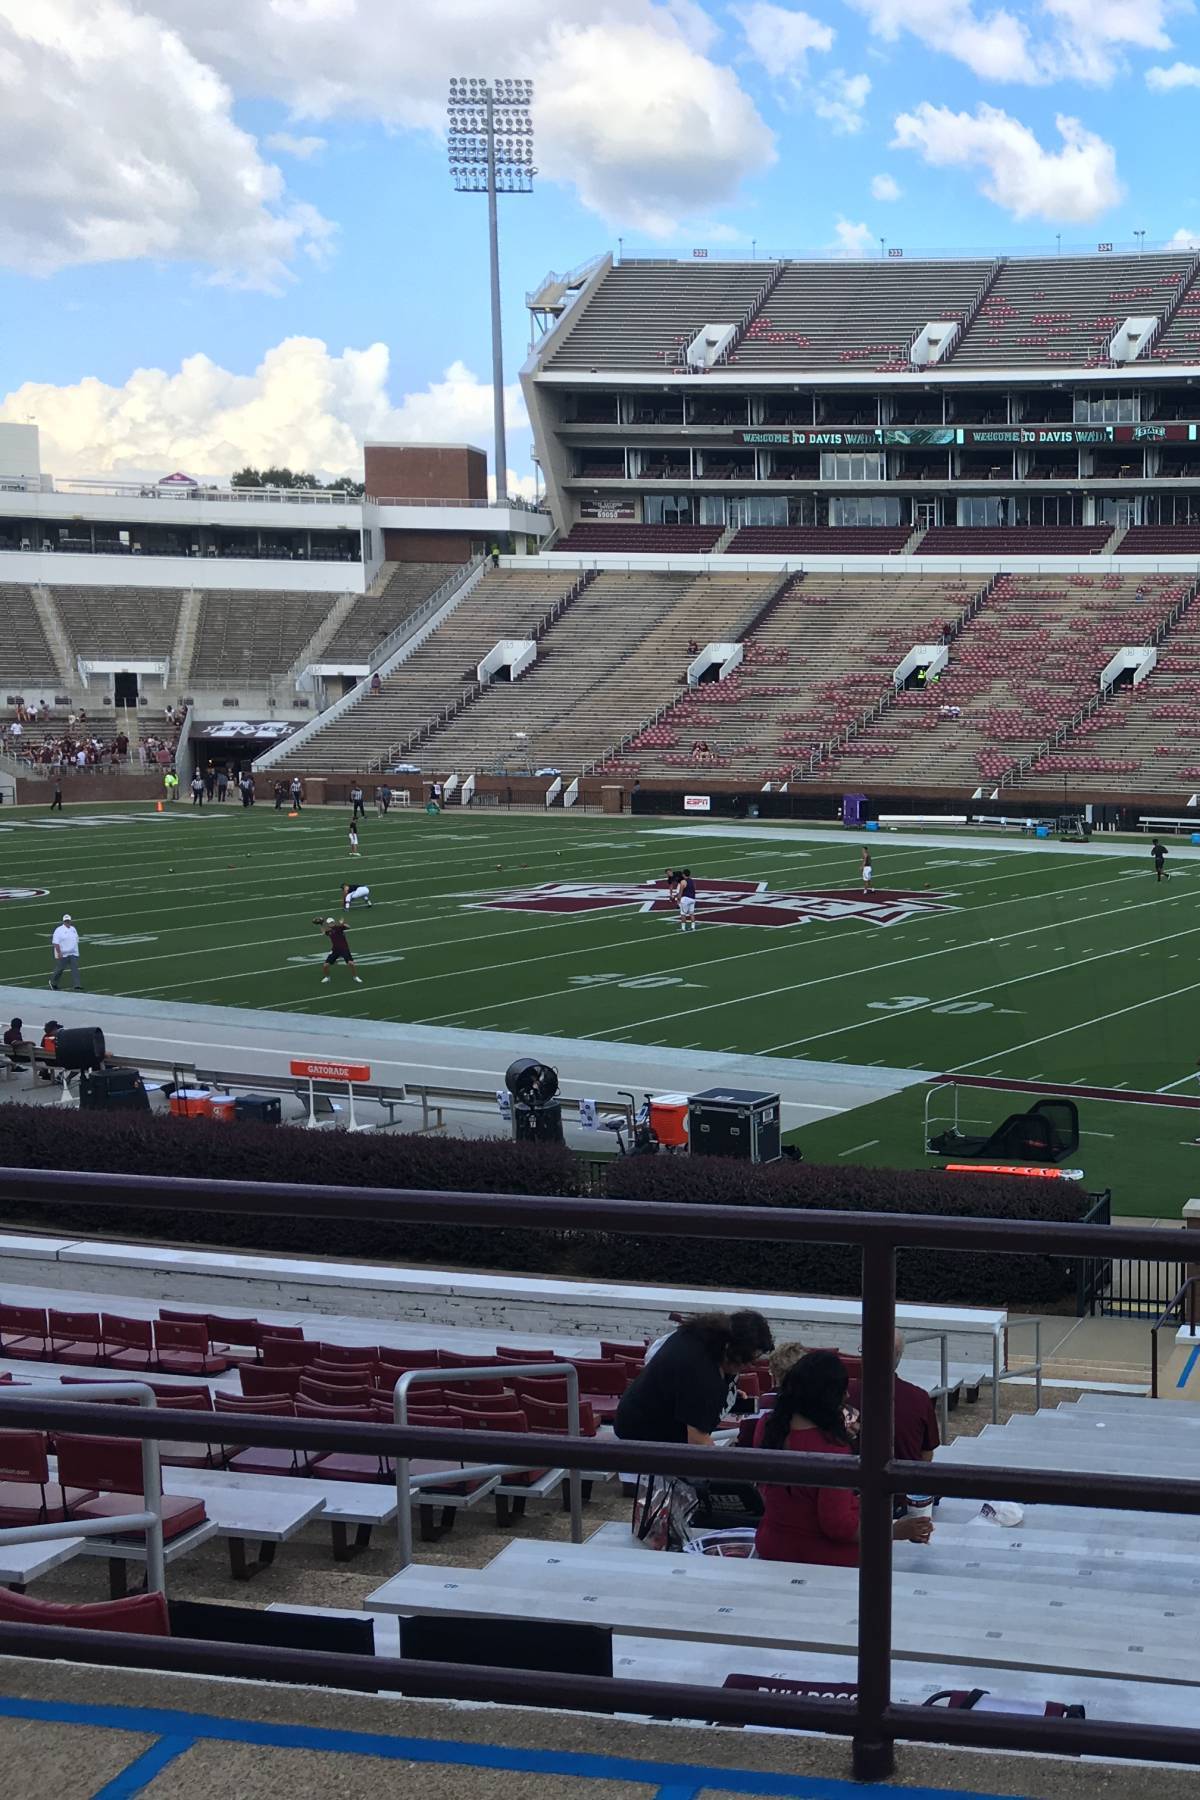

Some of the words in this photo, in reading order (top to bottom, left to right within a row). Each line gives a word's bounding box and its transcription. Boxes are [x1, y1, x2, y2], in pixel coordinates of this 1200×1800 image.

[743, 433, 789, 443] WELCOME
[793, 433, 805, 444] TO
[810, 434, 841, 444] DAVIS
[973, 432, 1019, 443] WELCOME
[1023, 432, 1035, 442] TO
[1040, 432, 1072, 441] DAVIS
[867, 996, 994, 1013] 30
[308, 1064, 349, 1077] GATORADE
